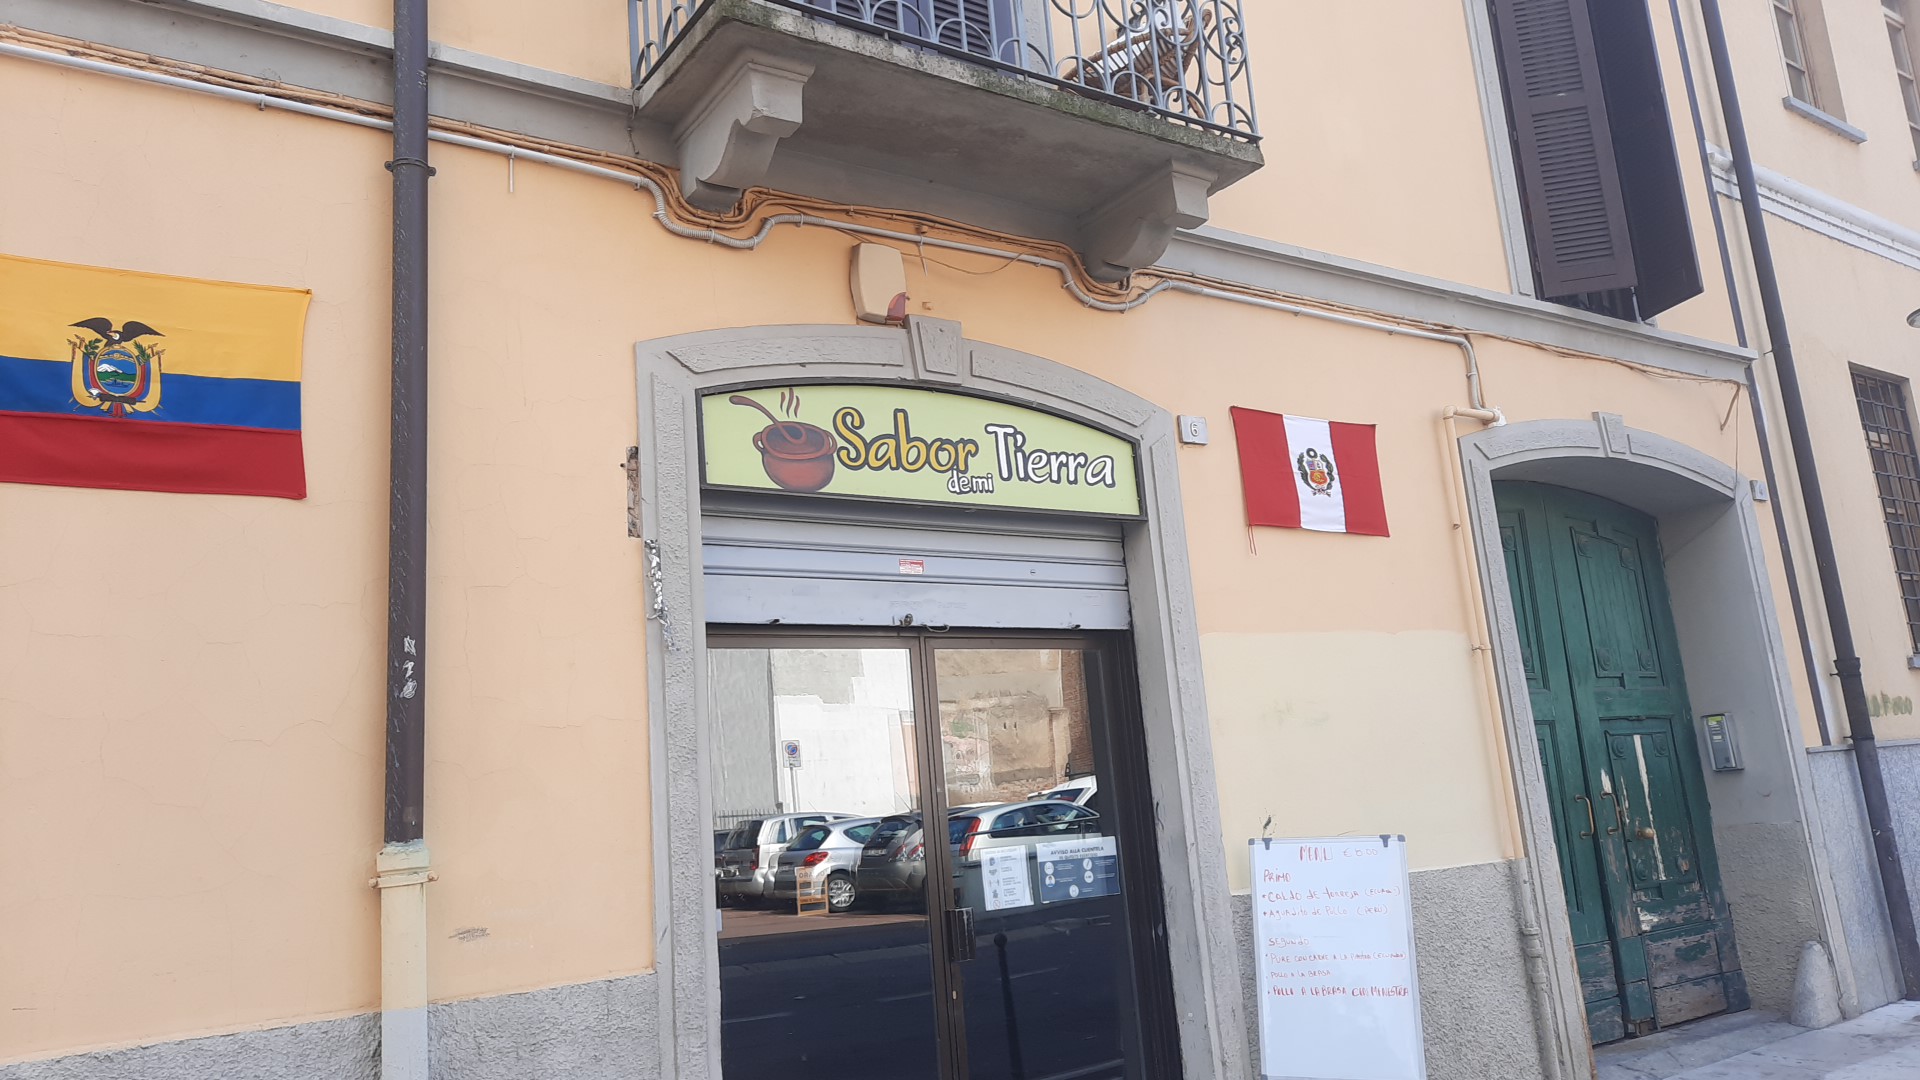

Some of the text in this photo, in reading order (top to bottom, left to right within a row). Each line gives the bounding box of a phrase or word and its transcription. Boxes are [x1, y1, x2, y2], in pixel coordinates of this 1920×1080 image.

[1190, 422, 1199, 437] 6
[833, 407, 1116, 488] Sabor Tierra
[1299, 845, 1333, 862] MENU
